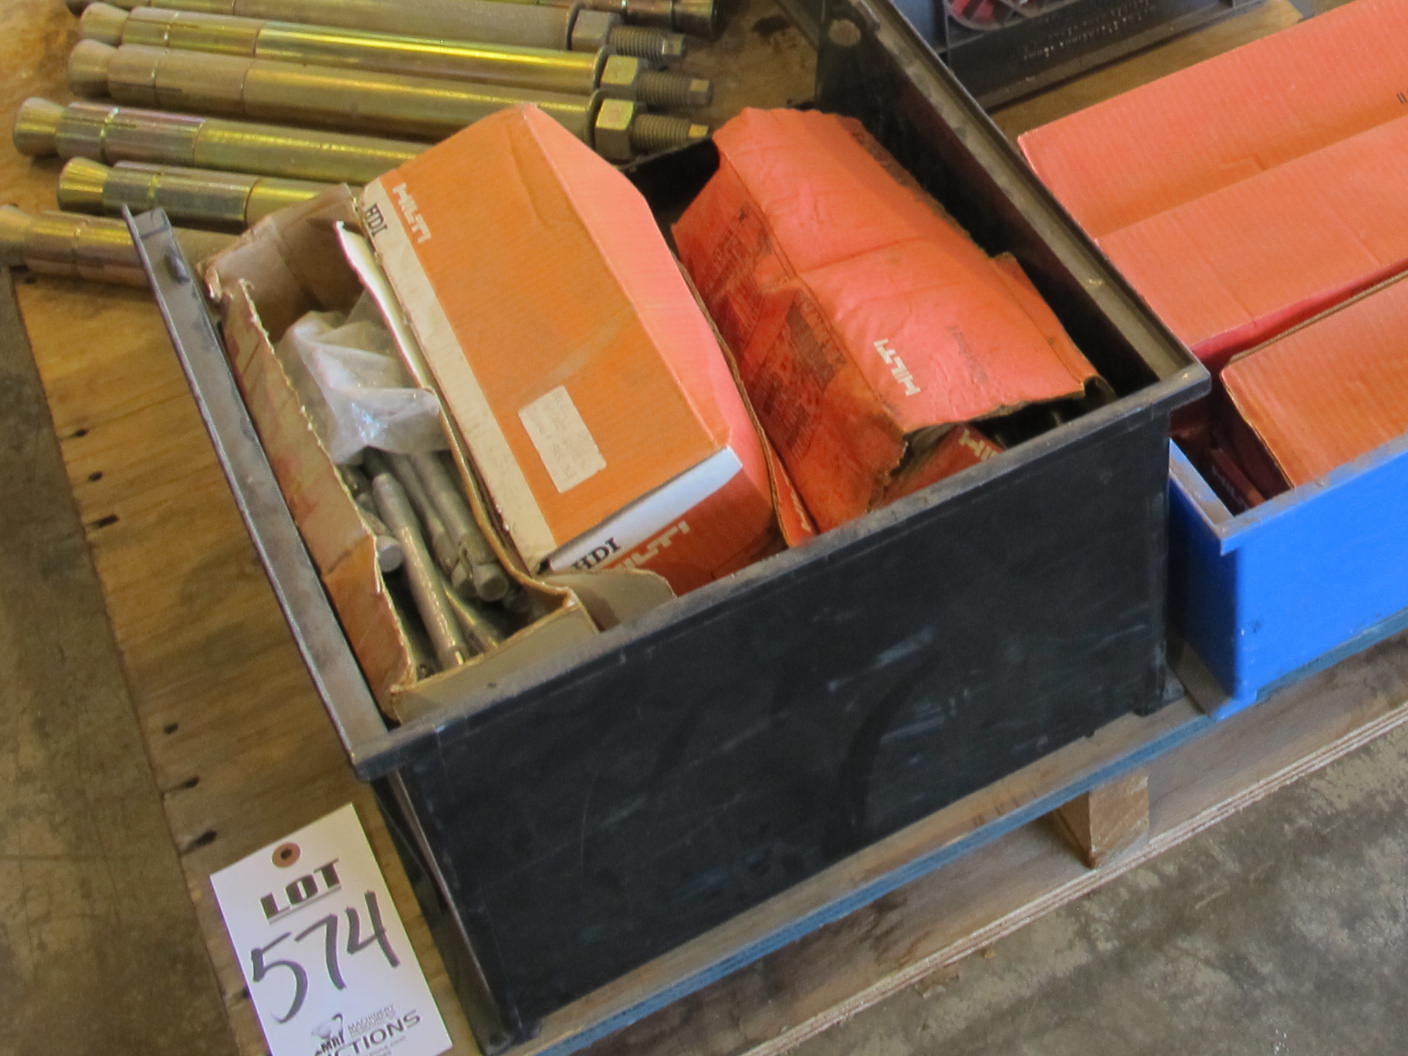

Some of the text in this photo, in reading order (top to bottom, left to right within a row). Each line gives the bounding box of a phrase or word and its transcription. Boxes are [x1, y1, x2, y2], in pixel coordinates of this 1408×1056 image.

[392, 182, 432, 244] HILTI
[873, 338, 922, 396] HILTI
[613, 520, 691, 569] ILTI
[259, 858, 342, 920] LOT
[250, 889, 400, 1024] 574
